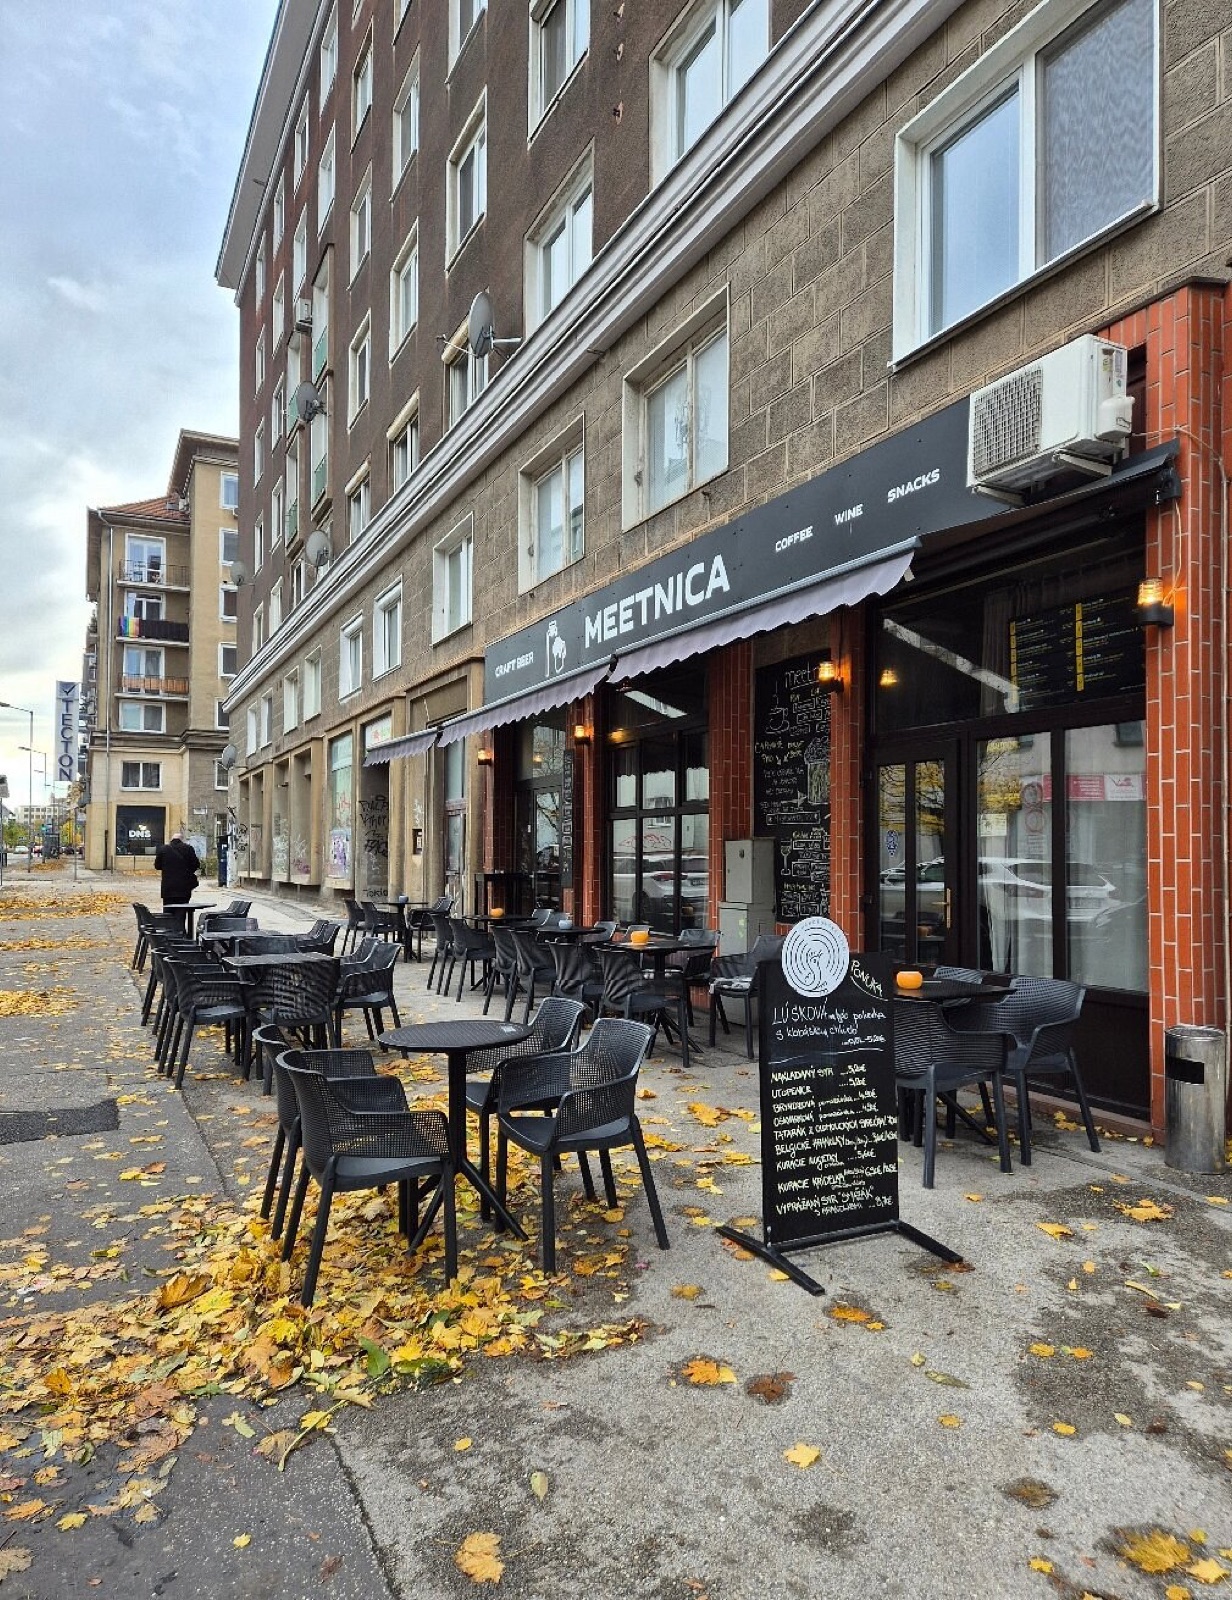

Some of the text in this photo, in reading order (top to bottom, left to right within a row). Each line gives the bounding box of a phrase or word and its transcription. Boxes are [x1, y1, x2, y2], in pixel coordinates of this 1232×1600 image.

[887, 468, 940, 503] SNACKS
[834, 503, 864, 526] WINE
[775, 525, 814, 553] COFFEE
[584, 554, 731, 650] MEETNICA
[494, 651, 534, 678] CRAFT BEER
[58, 699, 74, 782] TECTON
[128, 829, 152, 838] DNS
[770, 1064, 816, 1084] NAKLADANÝ
[773, 1124, 807, 1141] TATARÁK
[774, 1138, 812, 1159] BELGICKÉ
[776, 1157, 806, 1172] KURACIE
[777, 1178, 809, 1194] KURACIE
